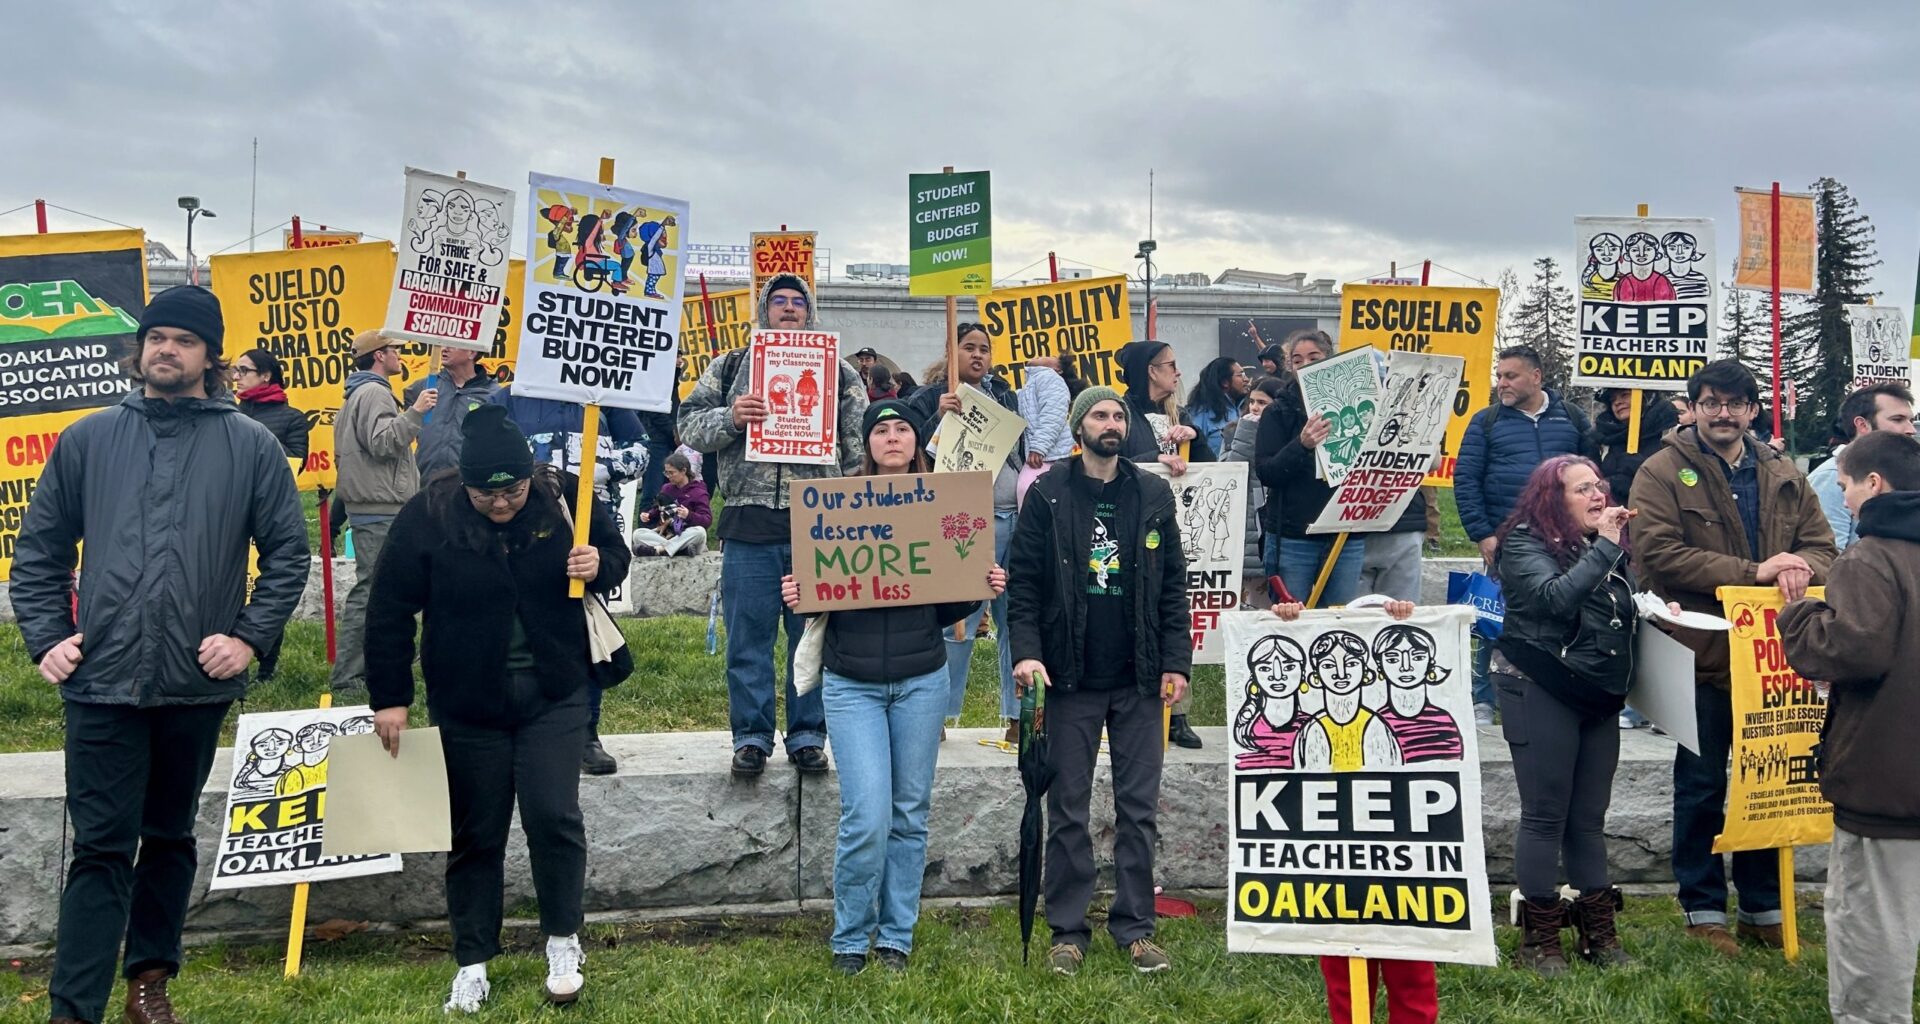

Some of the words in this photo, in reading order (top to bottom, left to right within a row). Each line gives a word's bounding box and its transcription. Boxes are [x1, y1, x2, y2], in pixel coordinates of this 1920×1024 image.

[917, 181, 975, 204] STUDENT
[915, 202, 981, 224] CENTERED
[769, 240, 800, 251] WE
[927, 222, 979, 243] BUDGET
[440, 243, 471, 260] STRIKE
[697, 253, 731, 265] FOR
[932, 247, 968, 264] NOW!
[418, 255, 441, 274] FOR
[443, 259, 476, 280] SAFE
[479, 268, 487, 283] &
[757, 262, 808, 273] WAIT
[249, 264, 346, 304] SUELDO
[402, 273, 463, 298] RACIALLY
[463, 282, 498, 303] JUST
[0, 281, 104, 320] OEA
[409, 292, 484, 319] COMMUNITY
[538, 291, 668, 329] STUDENT
[984, 284, 1122, 336] STABILITY
[259, 297, 339, 335] JUSTO
[410, 311, 474, 339] SCHOOLS
[904, 319, 946, 329] PROGRE
[1351, 298, 1483, 334] ESCUELAS
[1582, 304, 1706, 335] KEEP
[256, 331, 312, 359] PARA
[317, 326, 355, 356] LOS
[526, 312, 673, 352] CENTERED
[1010, 333, 1050, 361] FOR
[1056, 324, 1101, 352] OUR
[1390, 333, 1430, 353] CON
[1581, 336, 1679, 353] TEACHERS
[1686, 339, 1706, 353] IN
[0, 344, 108, 367] OAKLAND
[542, 337, 656, 372] BUDGET
[769, 360, 781, 368] my
[783, 359, 821, 367] Classroom
[781, 351, 807, 359] Future
[816, 352, 824, 360] in
[1, 361, 120, 387] DUCATION
[560, 363, 632, 391] NOW!
[1857, 364, 1908, 377] STUDENT
[0, 378, 131, 406] SSOCIATION
[777, 416, 808, 424] Student
[968, 411, 983, 425] Our
[971, 405, 989, 424] Save
[764, 429, 792, 438] Budget
[6, 432, 59, 466] CAN
[1353, 450, 1431, 471] STUDENT
[1329, 468, 1344, 480] WE
[1340, 469, 1425, 488] CENTERED
[802, 486, 846, 510] Our
[850, 477, 936, 509] students
[1337, 488, 1409, 504] BUDGET
[1339, 505, 1387, 521] NOW!
[810, 513, 894, 541] deserve
[814, 541, 932, 579] MORE
[815, 576, 862, 602] not
[872, 576, 911, 601] less
[1745, 711, 1774, 725] INVIERTA
[1775, 709, 1784, 722] EN
[1784, 708, 1796, 721] LAS
[1797, 707, 1826, 720] ESCUE
[1742, 725, 1774, 740] NUESTROS
[1776, 720, 1822, 736] ESTUDIANTES
[230, 791, 326, 834] KE
[1240, 779, 1457, 833] KEEP
[226, 825, 323, 852] TEACHE
[1238, 842, 1413, 872] TEACHERS
[1425, 845, 1463, 872] IN
[1239, 880, 1466, 924] OAKLAND
